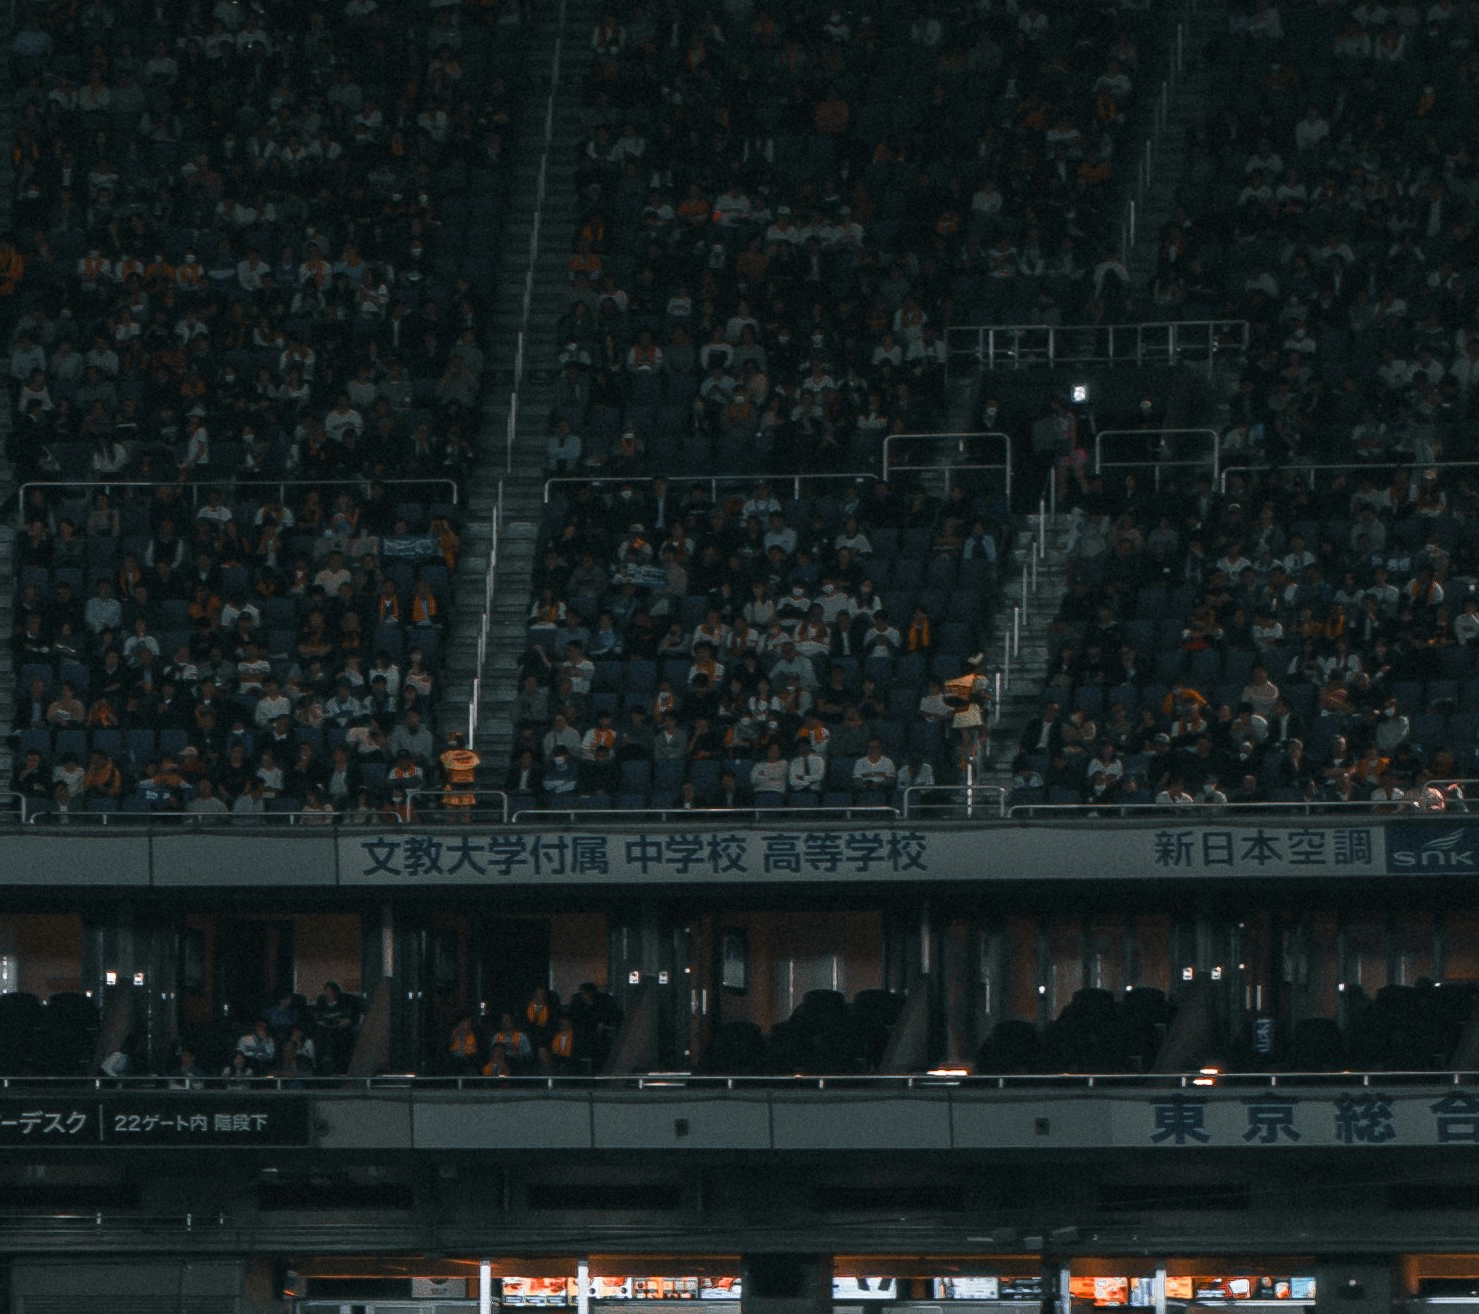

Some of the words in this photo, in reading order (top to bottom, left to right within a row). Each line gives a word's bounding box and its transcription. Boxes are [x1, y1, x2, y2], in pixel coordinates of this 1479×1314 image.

[360, 835, 610, 877] 文教大学付属
[624, 834, 748, 875] 中学校
[760, 832, 929, 874] 高等学校
[1153, 828, 1373, 867] 新日本空調
[114, 1113, 208, 1131] 22ゲート内
[213, 1113, 269, 1131] 階段下
